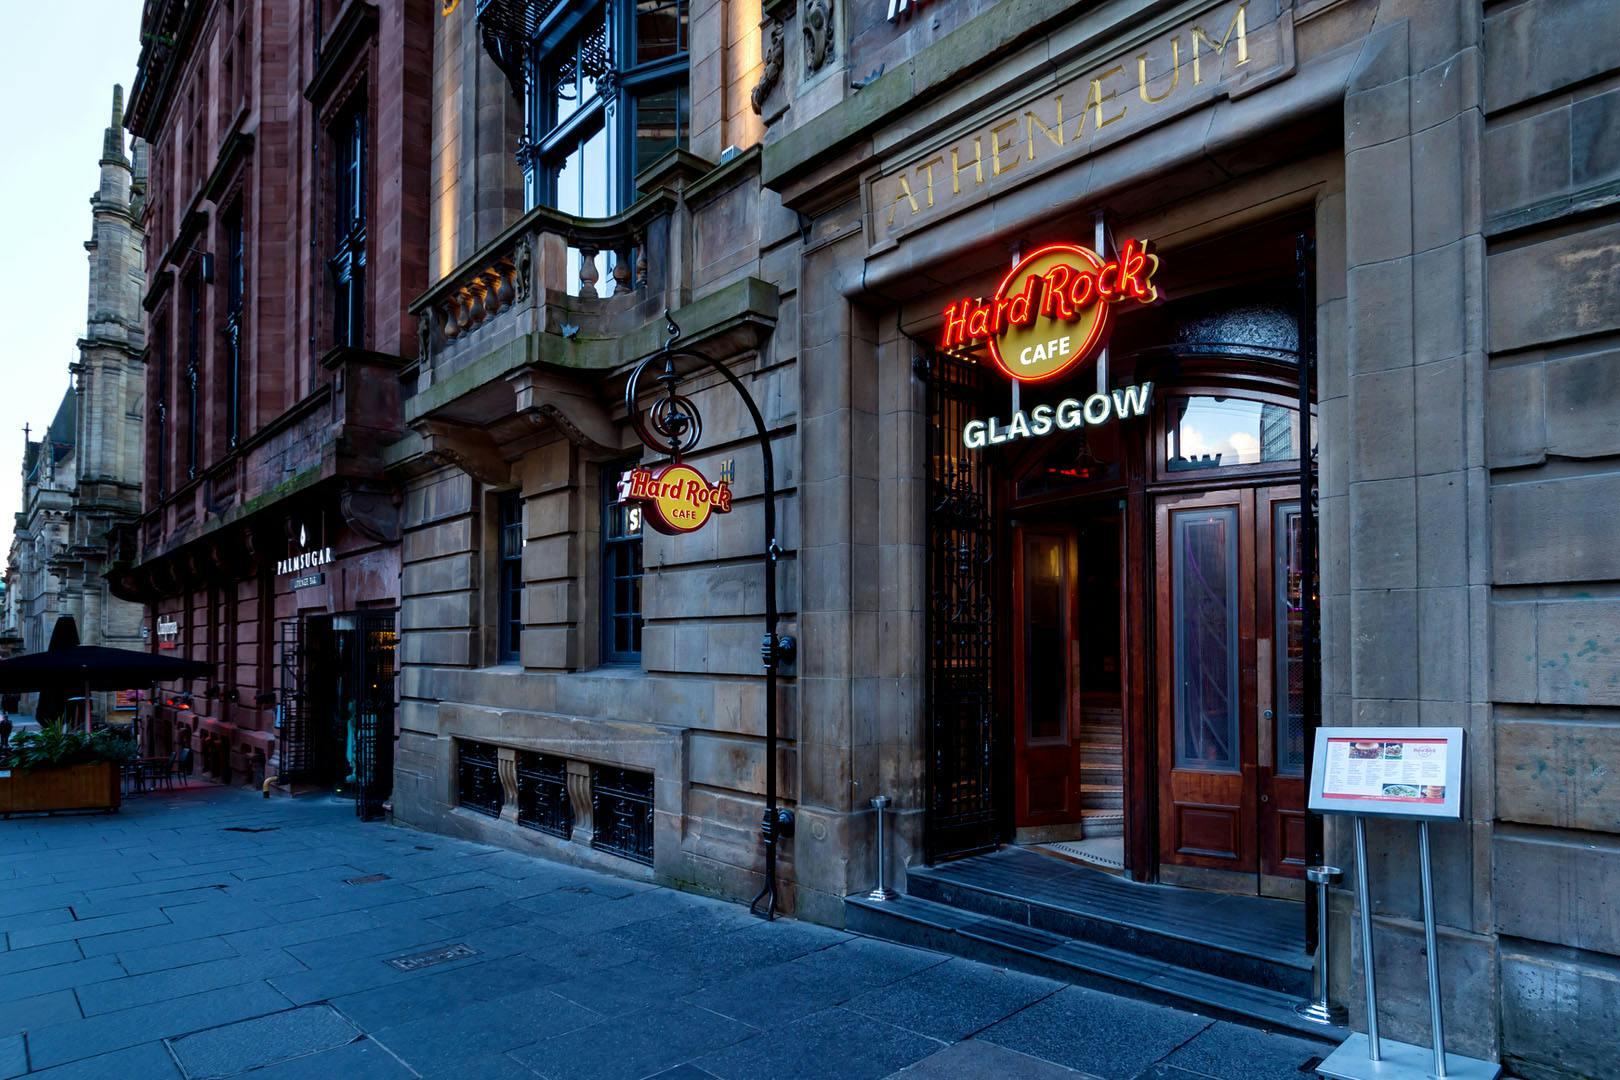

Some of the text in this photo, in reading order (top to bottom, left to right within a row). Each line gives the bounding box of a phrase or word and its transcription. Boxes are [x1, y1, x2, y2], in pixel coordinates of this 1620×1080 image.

[887, 2, 1251, 228] ATHENÆUM
[941, 239, 1150, 347] Hard Rock
[1020, 336, 1070, 366] CAFE
[963, 381, 1154, 449] GLASGOW
[630, 470, 733, 513] Hard Rock
[672, 508, 697, 520] CAFE
[277, 547, 331, 576] PALMSUGAR
